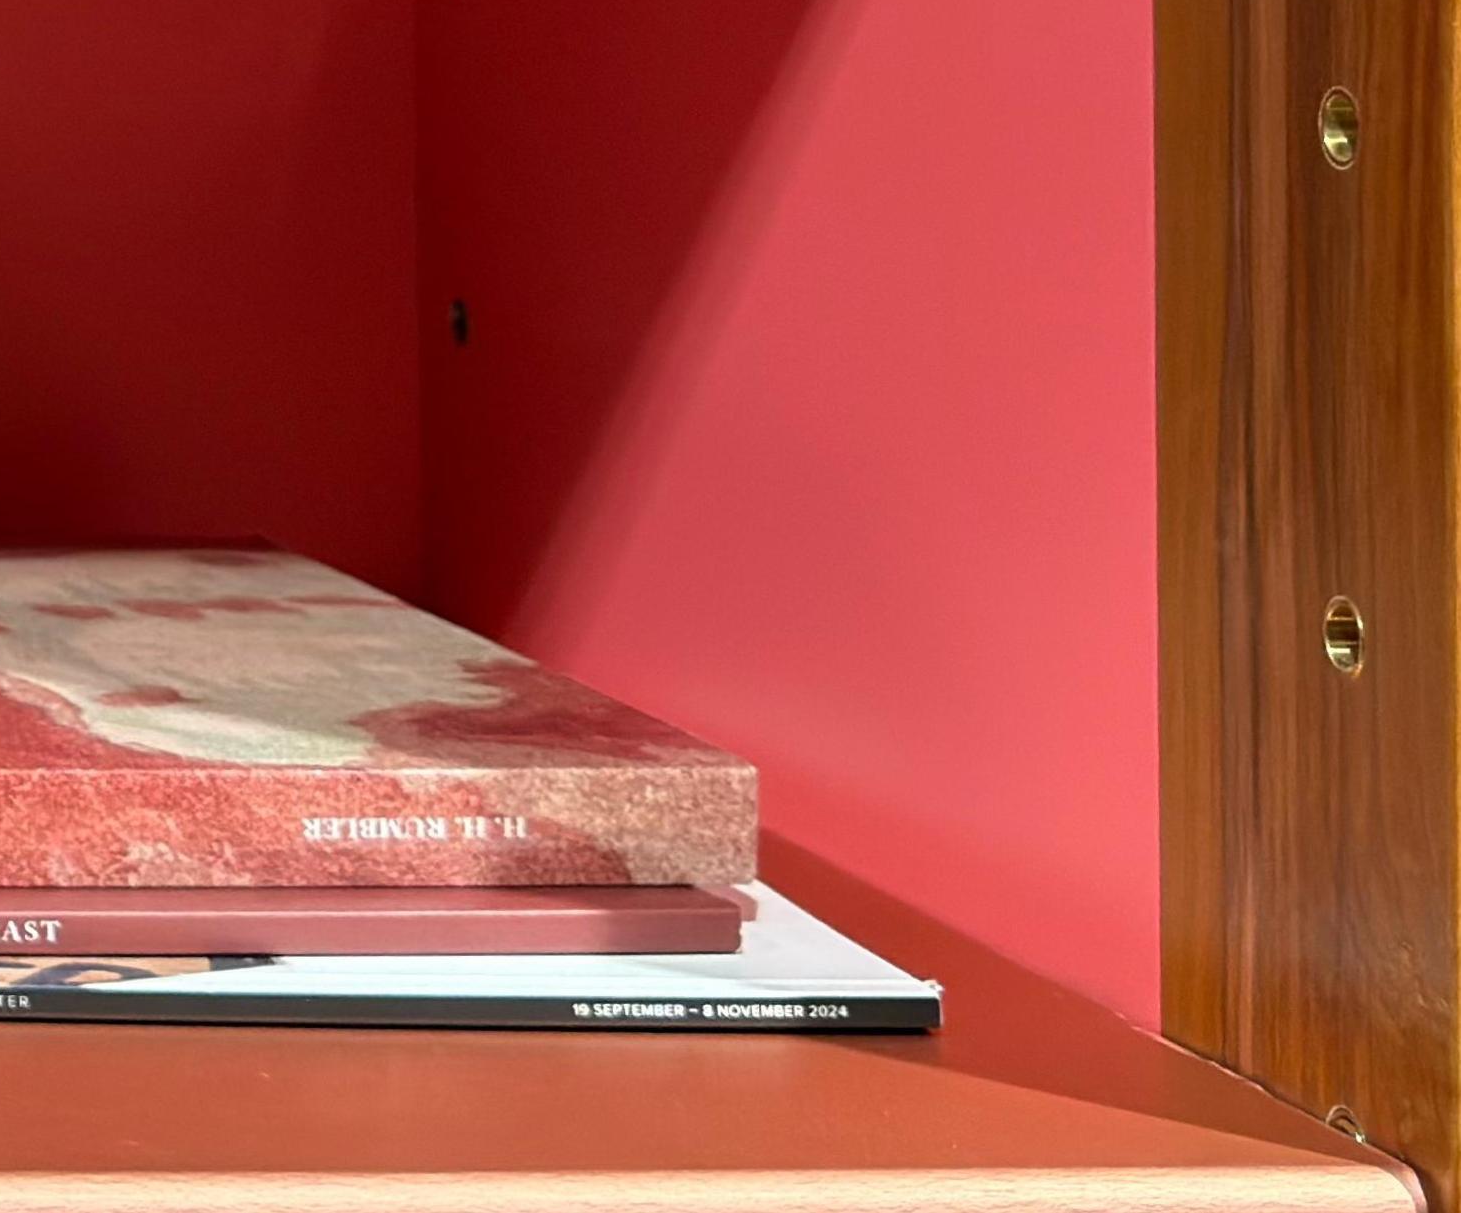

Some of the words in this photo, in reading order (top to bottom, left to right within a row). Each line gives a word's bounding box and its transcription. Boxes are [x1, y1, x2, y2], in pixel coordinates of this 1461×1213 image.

[301, 817, 447, 840] RUMBLER
[454, 817, 488, 840] H.
[494, 817, 528, 840] H.
[572, 1003, 590, 1017] 19
[593, 1003, 685, 1018] SEPTEMBER
[702, 1004, 714, 1018] 8
[717, 1004, 804, 1019] NOVEMBER
[808, 1004, 849, 1018] 2024
